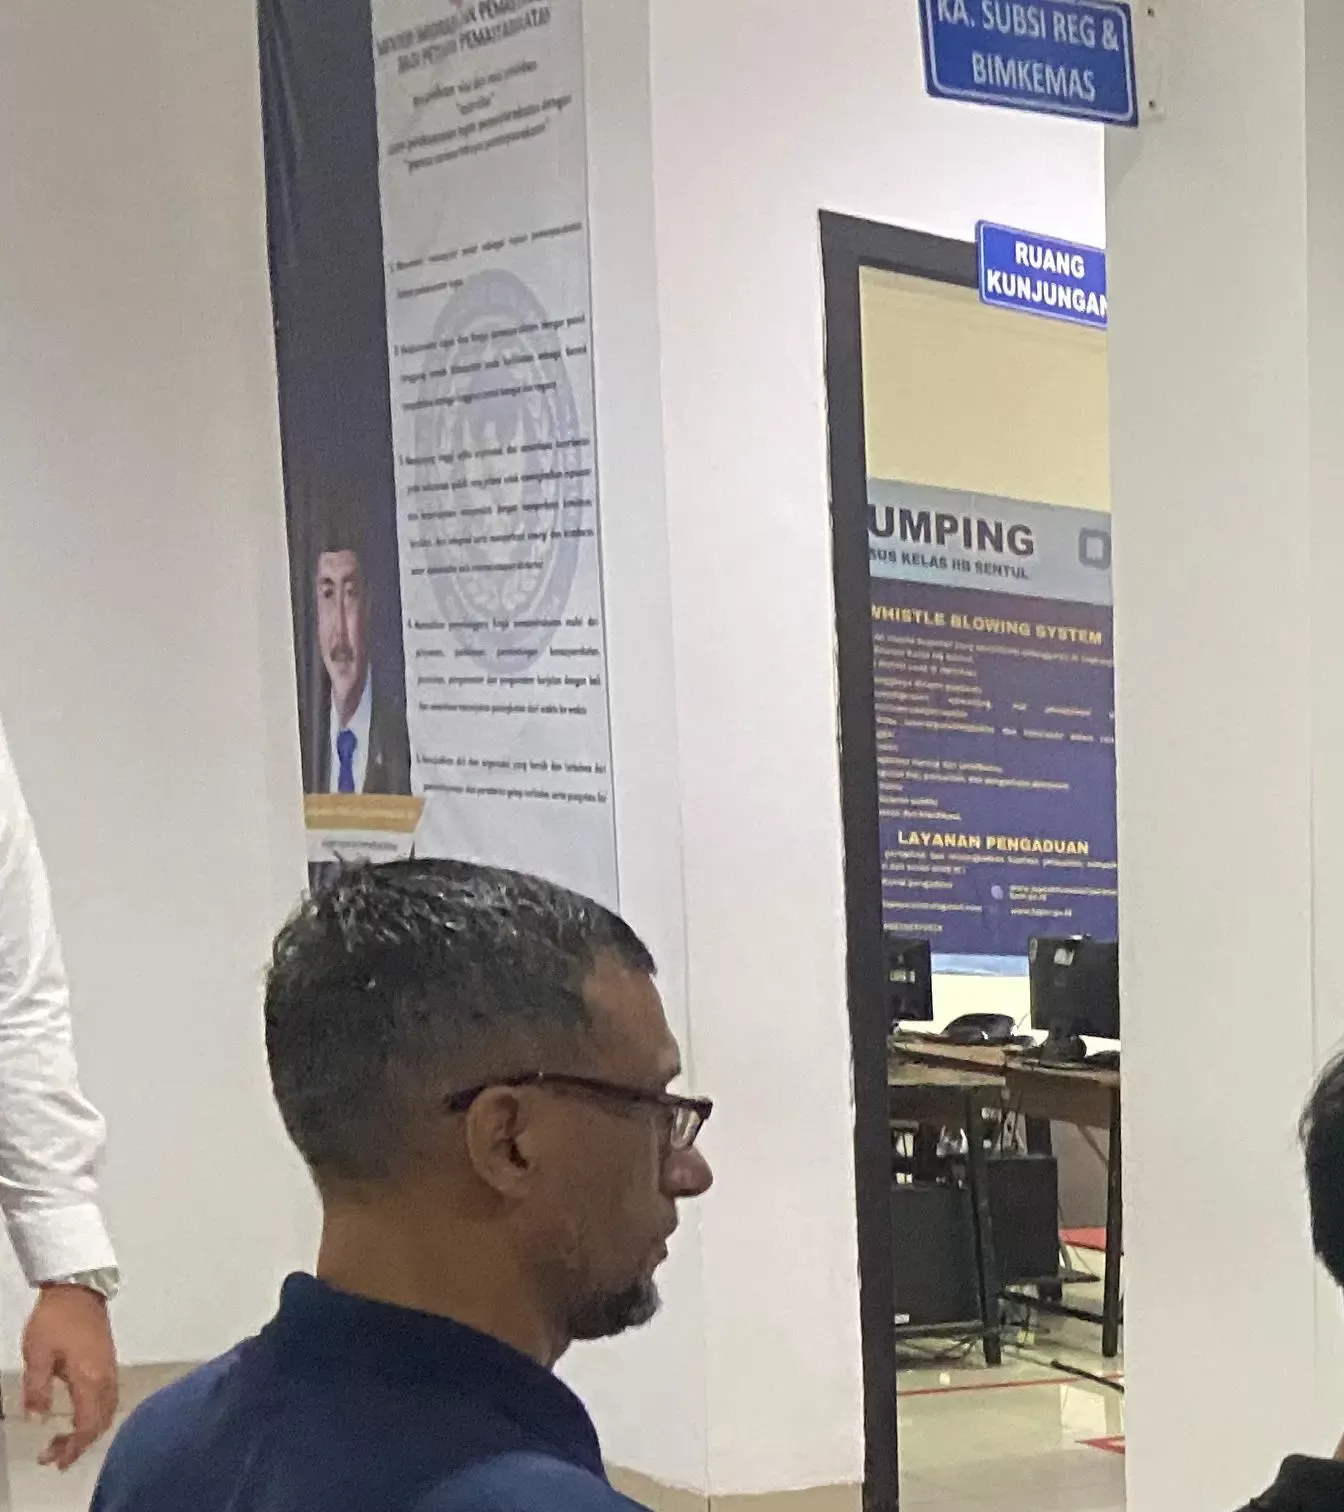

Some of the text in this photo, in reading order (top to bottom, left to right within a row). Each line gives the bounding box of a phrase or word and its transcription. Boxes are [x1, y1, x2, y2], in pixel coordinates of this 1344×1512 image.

[938, 0, 1119, 51] KA. SUBSI REG &
[972, 52, 1096, 102] BIMKEMAS
[1015, 241, 1085, 279] RUANG
[901, 551, 948, 569] KELAS
[975, 560, 1029, 580] SENTUL
[950, 613, 1032, 637] BLOWING
[1035, 624, 1102, 645] SYSTEM
[897, 830, 1089, 855] LAYANAN PENGADUAN
